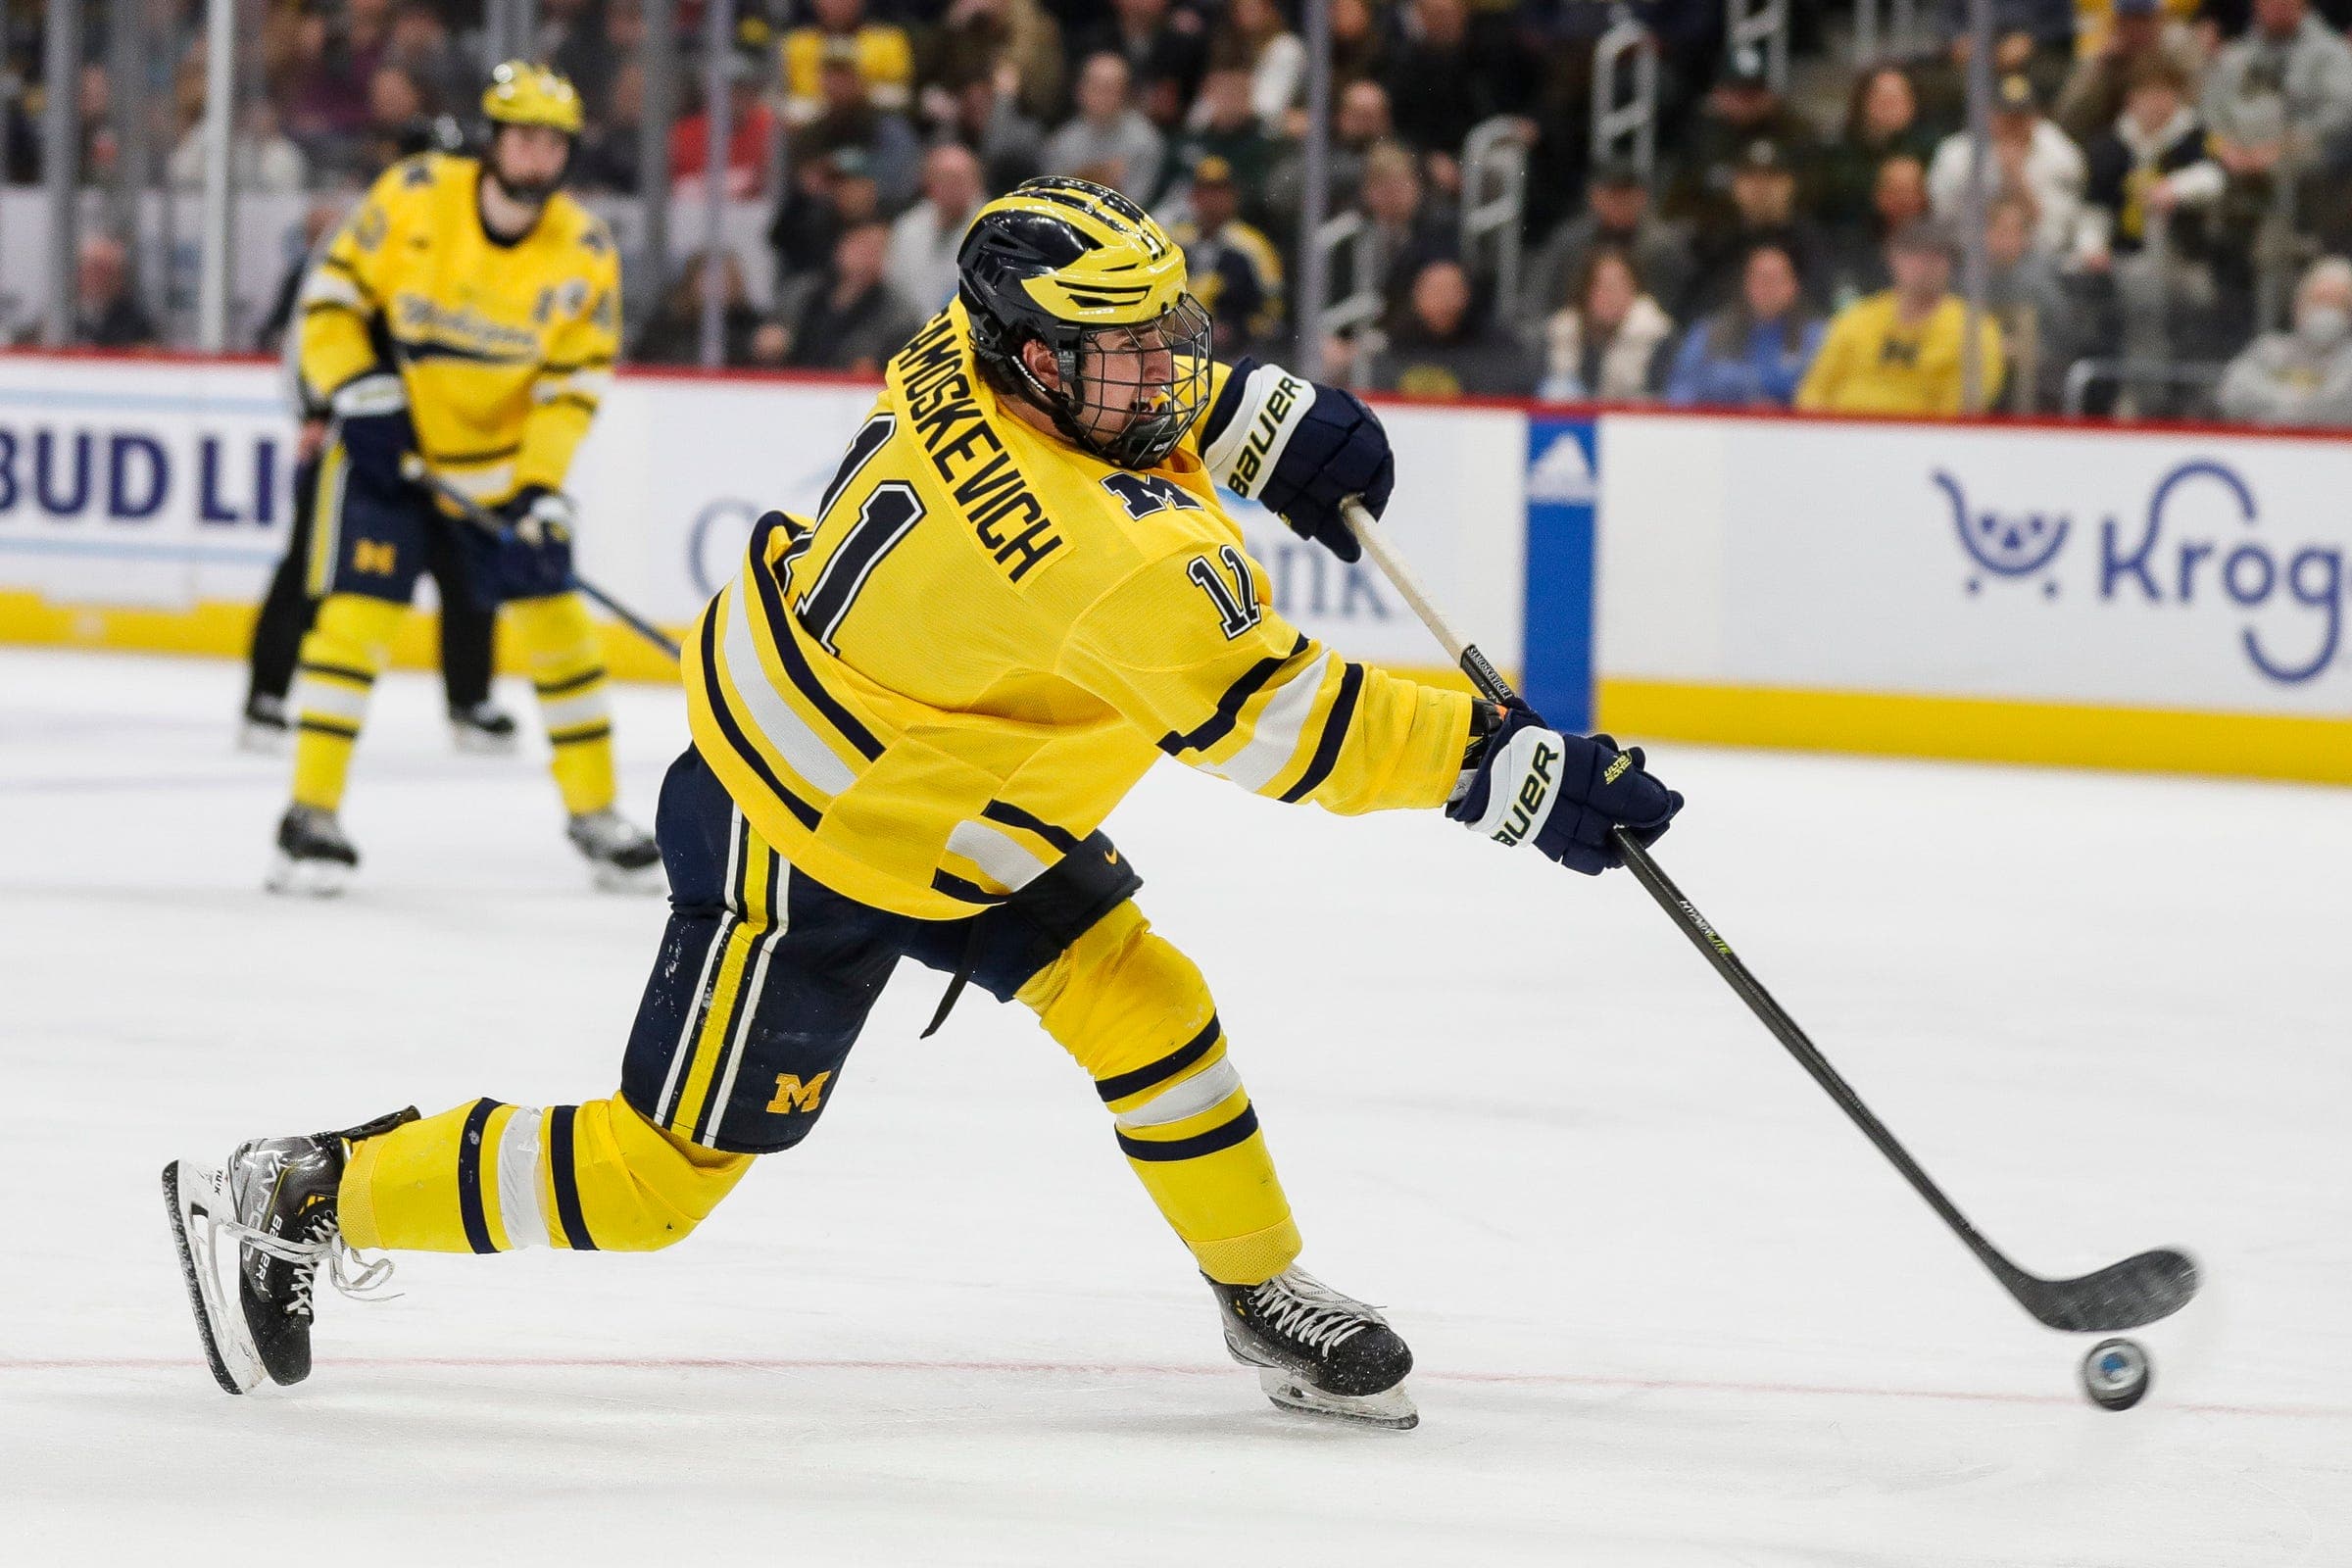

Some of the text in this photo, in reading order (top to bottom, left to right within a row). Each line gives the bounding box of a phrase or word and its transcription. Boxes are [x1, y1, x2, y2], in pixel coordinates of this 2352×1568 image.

[897, 307, 1063, 585] AMOSKEVICH
[1228, 375, 1303, 498] BAUER
[772, 412, 928, 658] 11
[1099, 469, 1204, 522] M
[1187, 543, 1262, 640] 11
[765, 1069, 831, 1115] M
[255, 1213, 283, 1281] BAER
